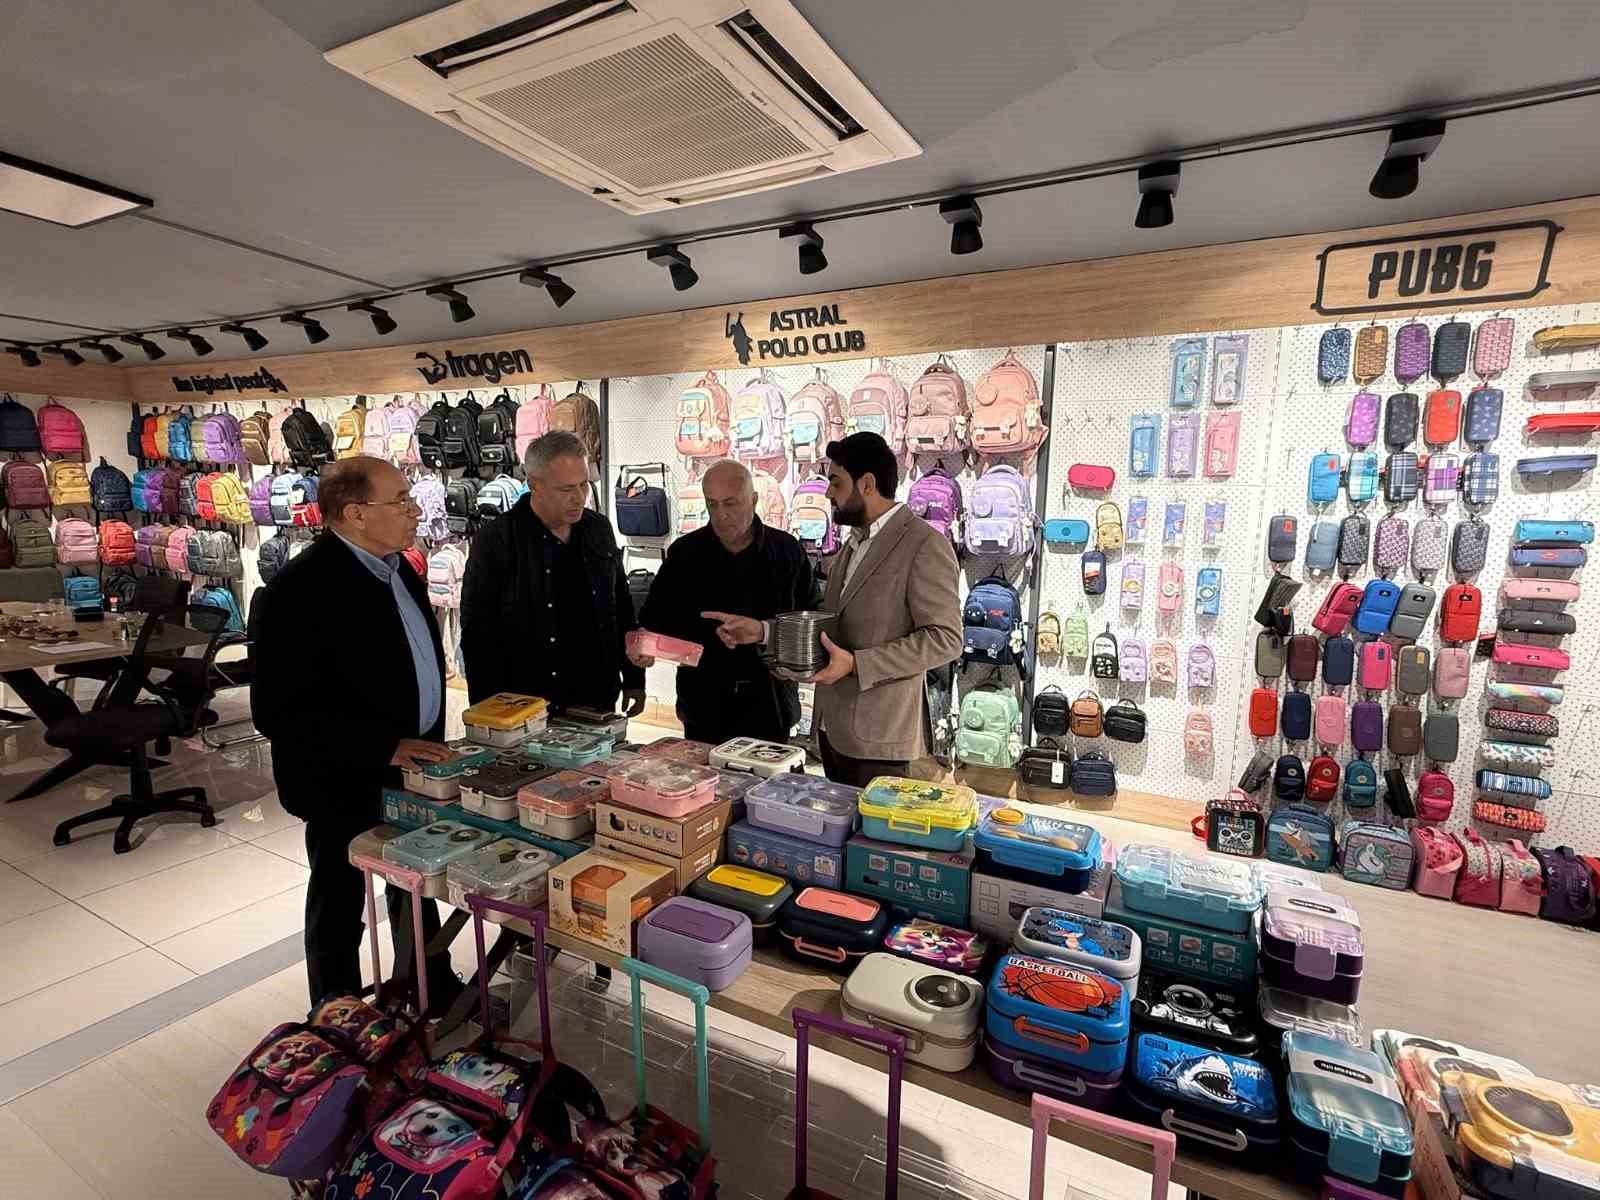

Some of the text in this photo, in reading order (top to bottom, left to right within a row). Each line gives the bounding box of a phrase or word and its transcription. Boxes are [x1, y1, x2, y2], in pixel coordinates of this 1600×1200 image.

[1368, 241, 1496, 299] PUBG
[769, 304, 847, 332] ASTRAL
[757, 330, 866, 359] POLO CLUB
[445, 349, 534, 384] tragen
[1008, 956, 1090, 984] BASKETBALL
